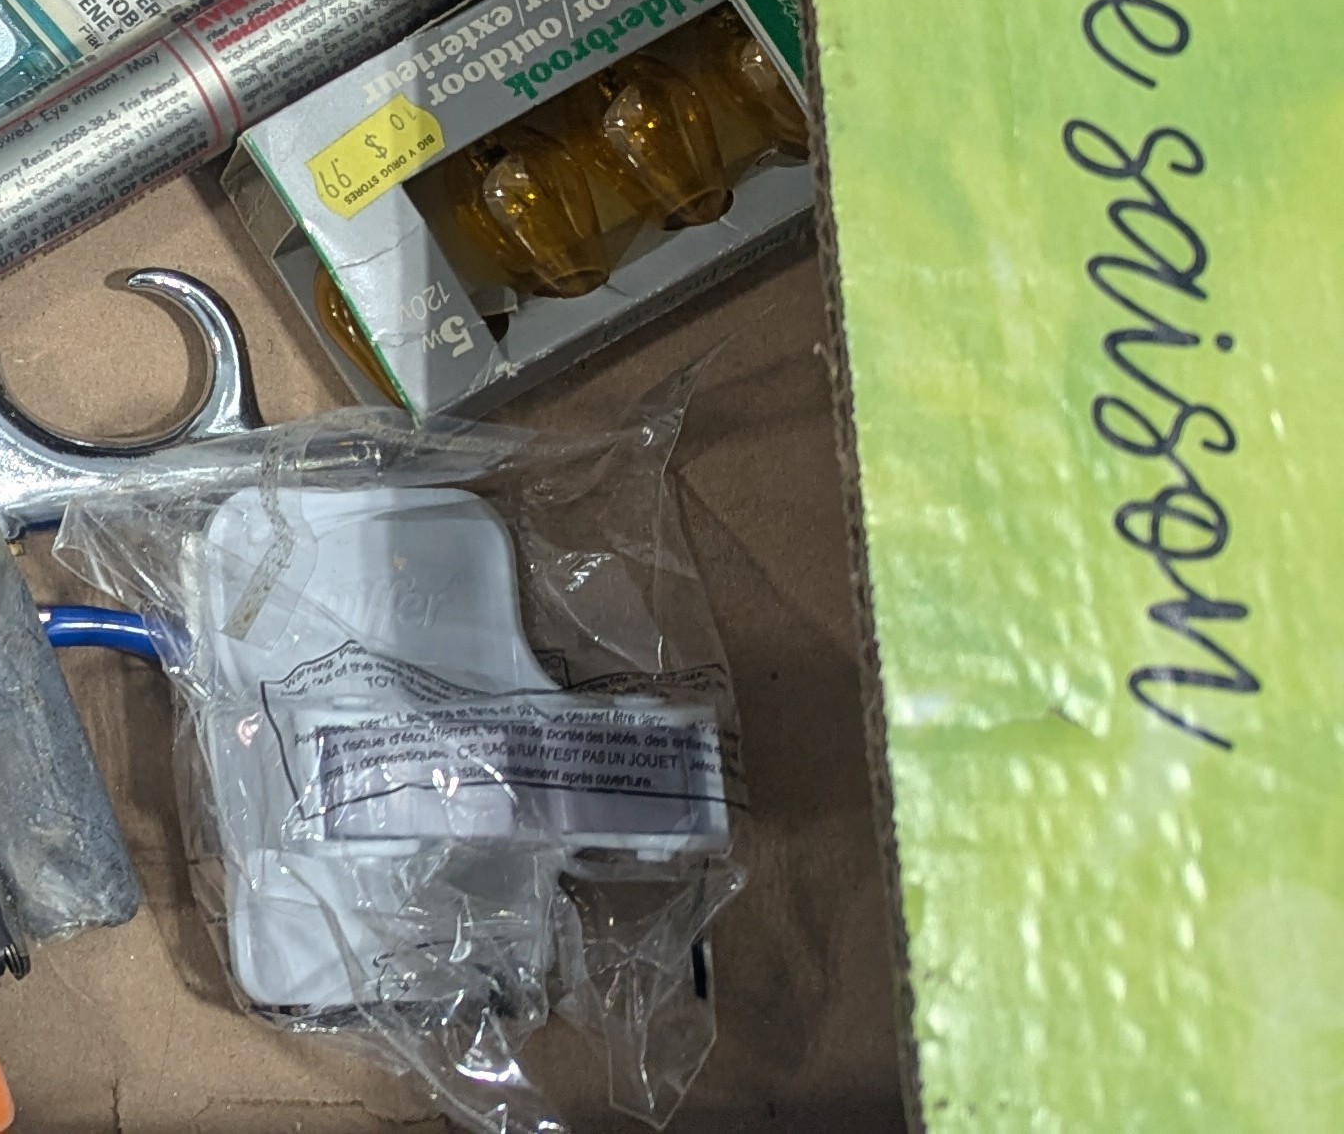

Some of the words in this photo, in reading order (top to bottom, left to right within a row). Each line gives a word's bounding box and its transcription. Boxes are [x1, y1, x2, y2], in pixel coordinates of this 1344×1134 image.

[229, 16, 246, 29] la
[39, 104, 69, 123] Eye
[68, 72, 125, 106] irritant.
[125, 49, 160, 75] May
[20, 148, 53, 169] Resin
[117, 92, 143, 115] Tris
[139, 71, 180, 101] Phenol
[414, 133, 436, 152] BIG
[379, 154, 408, 178] DRUG
[343, 175, 380, 205] STORES
[1062, 117, 1262, 753] saison
